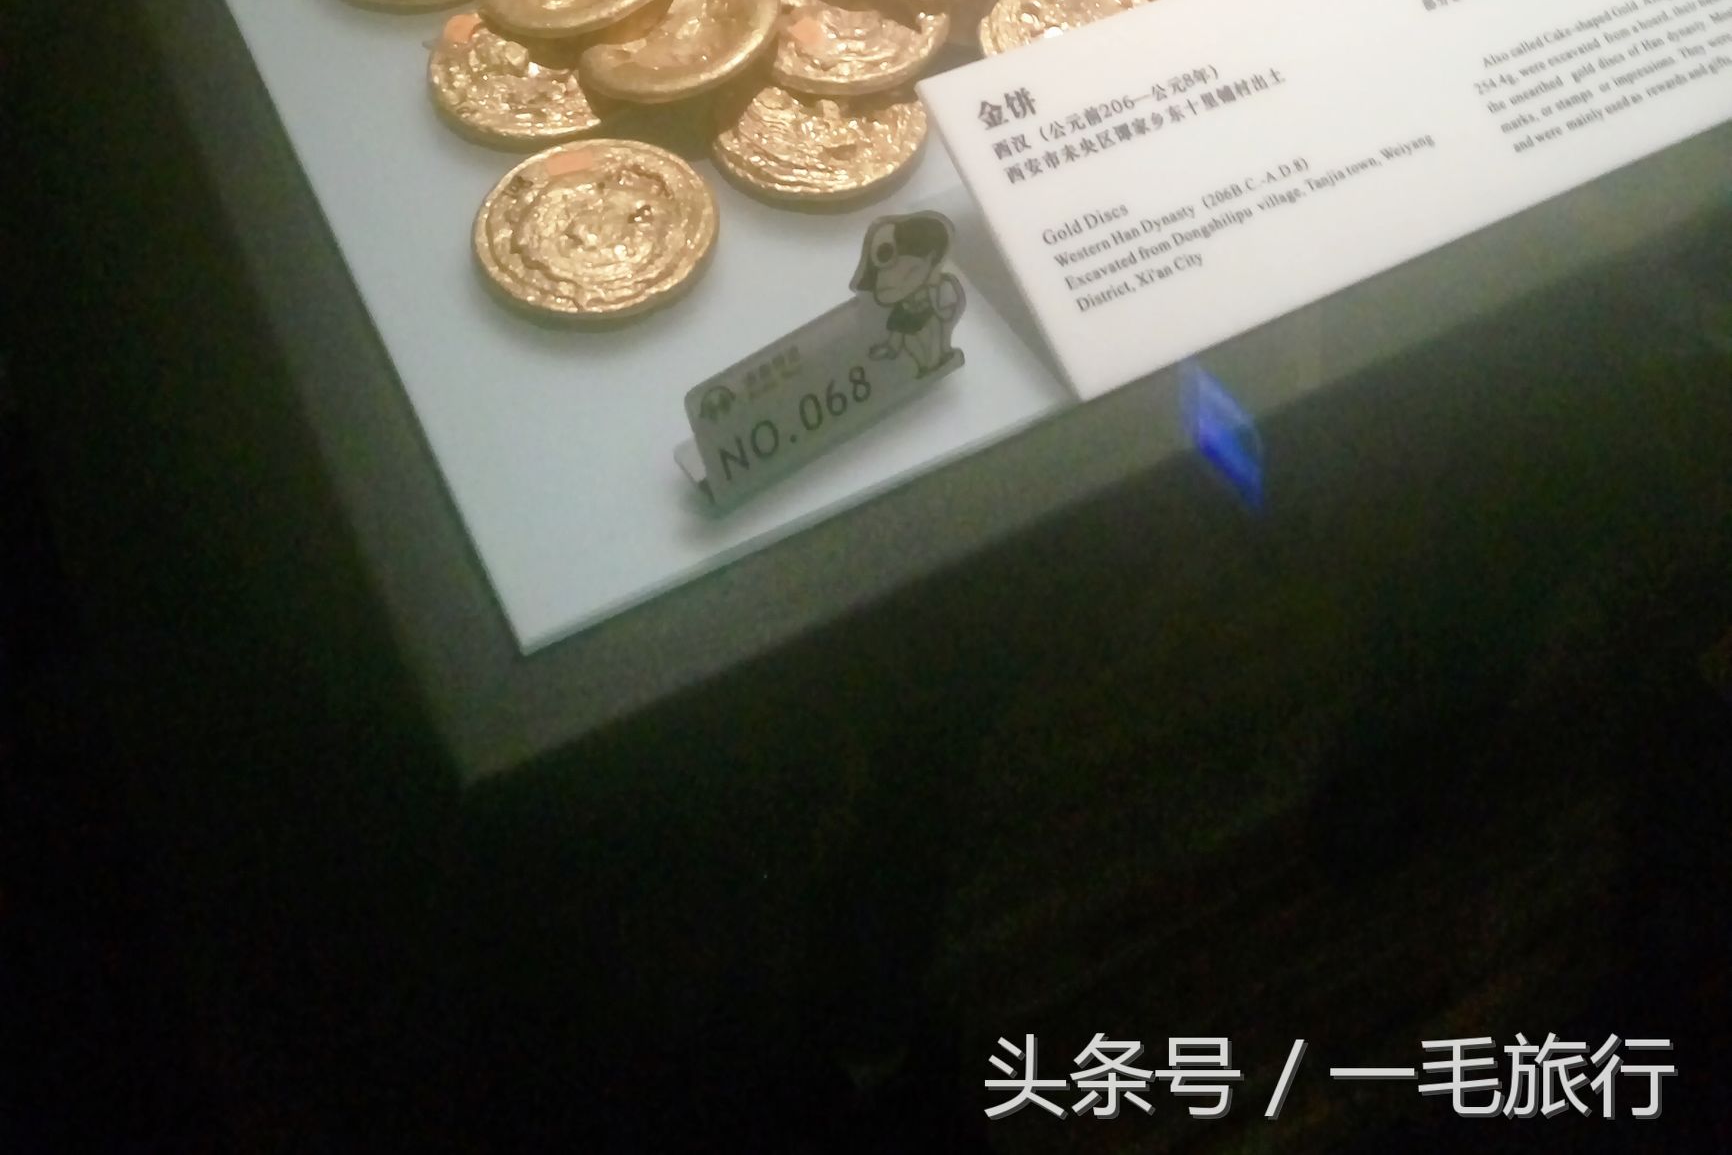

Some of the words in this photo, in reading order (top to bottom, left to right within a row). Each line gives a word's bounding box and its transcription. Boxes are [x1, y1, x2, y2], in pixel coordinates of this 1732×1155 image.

[1483, 53, 1509, 68] Also
[1510, 36, 1545, 58] called
[1519, 61, 1546, 78] were
[1547, 38, 1602, 68] excavated
[977, 87, 1037, 130] 金饼
[1487, 100, 1507, 114] the
[1508, 75, 1564, 106] unearthed
[1570, 62, 1597, 84] gold
[1512, 134, 1535, 153] and
[1534, 126, 1563, 143] were
[1566, 107, 1604, 131] mainly
[1042, 218, 1084, 246] Gold
[1083, 204, 1129, 231] Discs
[1054, 239, 1112, 268] Western
[1110, 226, 1142, 246] Han
[1139, 205, 1197, 232] Dynasty
[1064, 250, 1138, 290] Excavated
[1137, 240, 1173, 261] from
[1171, 207, 1254, 247] Dongshilipu
[1257, 186, 1307, 212] village,
[1304, 169, 1346, 193] Tanjia
[1345, 156, 1383, 177] town,
[1379, 134, 1436, 162] Weiyang
[1075, 280, 1137, 313] District,
[1134, 264, 1174, 288] Xi'an
[1173, 252, 1204, 272] City
[717, 366, 872, 481] NO.068
